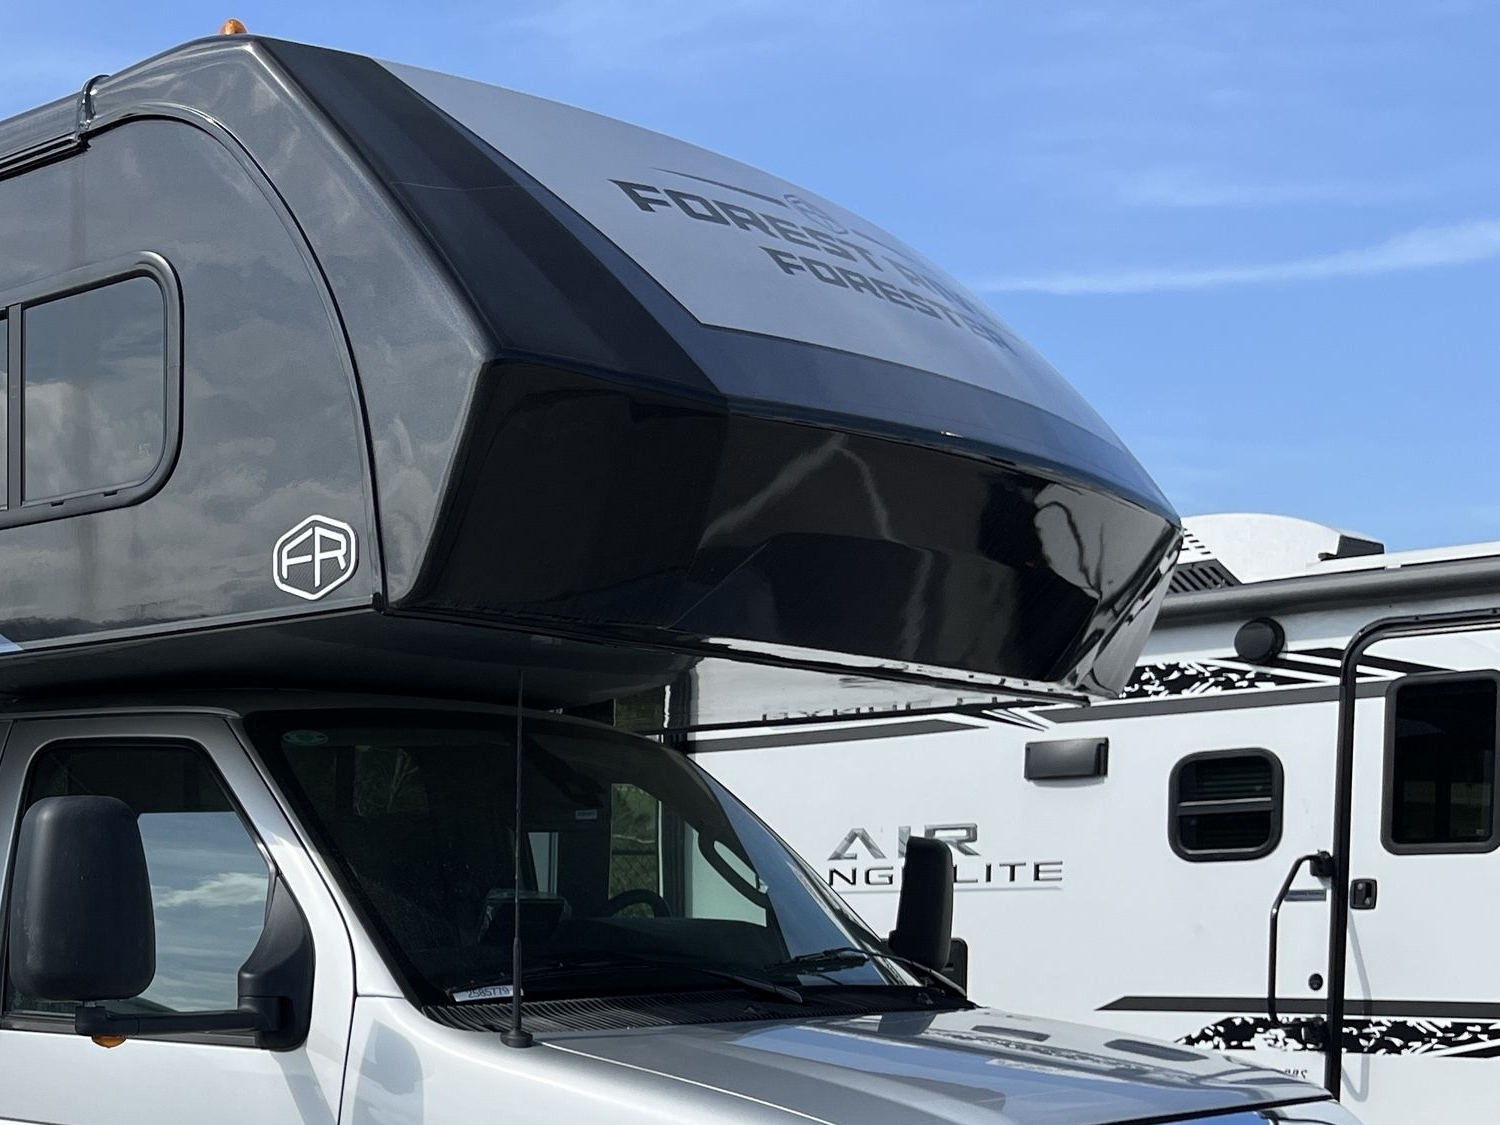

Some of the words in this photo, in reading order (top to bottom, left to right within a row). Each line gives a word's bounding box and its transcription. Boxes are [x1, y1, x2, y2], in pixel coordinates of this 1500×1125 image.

[607, 178, 884, 272] FOREST
[758, 246, 1019, 358] FORESTER
[281, 526, 347, 588] FR
[828, 823, 981, 860] AIR
[953, 861, 1063, 883] LITE
